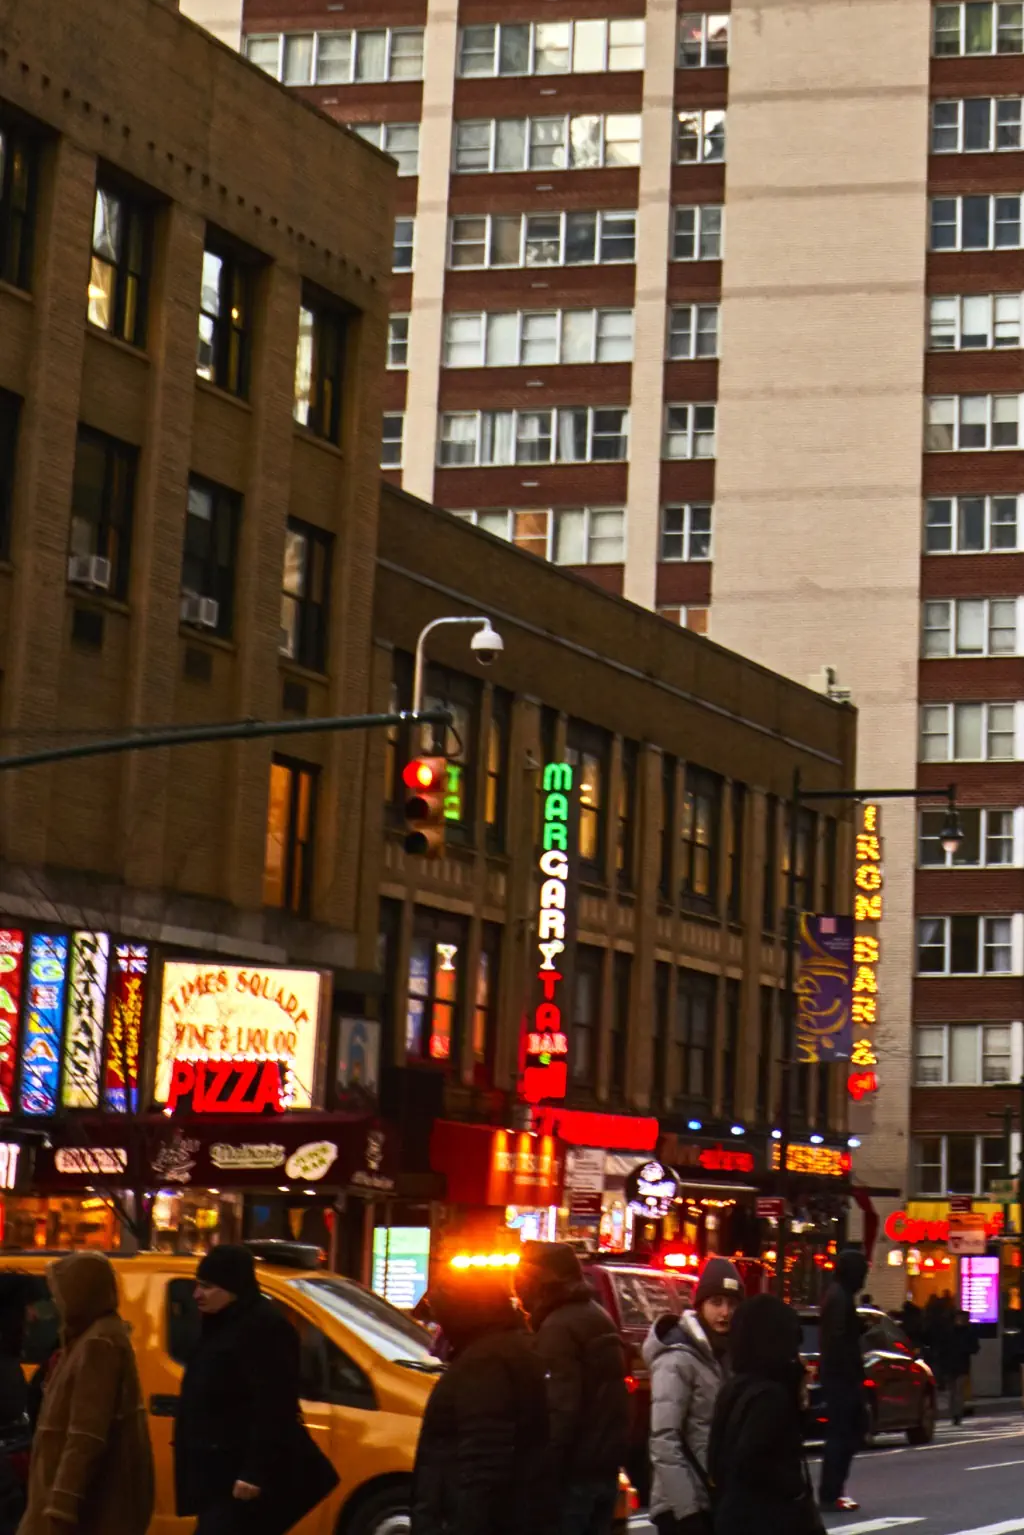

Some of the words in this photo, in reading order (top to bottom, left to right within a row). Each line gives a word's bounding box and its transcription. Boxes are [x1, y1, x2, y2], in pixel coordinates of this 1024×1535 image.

[854, 804, 883, 921] IRON
[168, 970, 229, 1015] TIMES
[235, 970, 310, 1025] SQUARE
[851, 935, 879, 1024] BAR
[20, 959, 65, 1112] GELATO
[236, 1025, 297, 1056] LIQUOR
[526, 1032, 568, 1054] BAR
[166, 1058, 287, 1113] PIZZA
